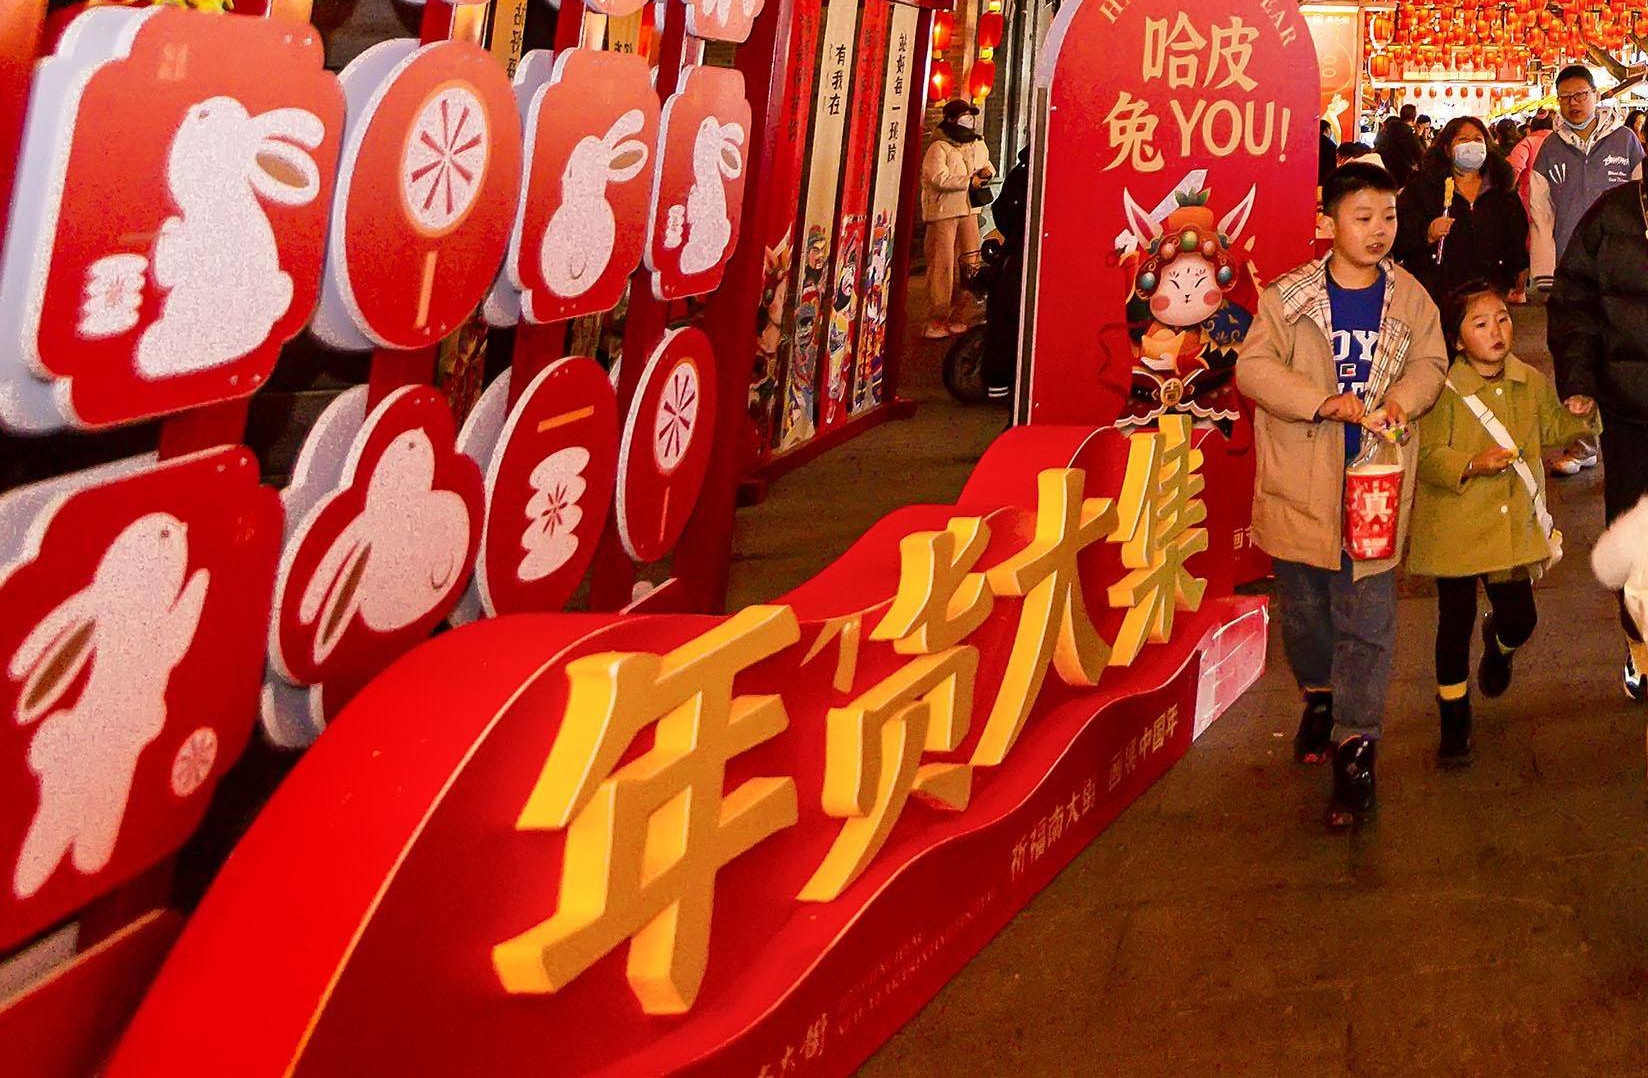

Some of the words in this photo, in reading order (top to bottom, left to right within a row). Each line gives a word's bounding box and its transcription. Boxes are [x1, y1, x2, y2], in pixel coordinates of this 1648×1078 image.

[827, 43, 847, 116] 有我在
[1142, 10, 1260, 92] 哈皮
[1100, 90, 1165, 173] 兔
[1168, 98, 1291, 163] YOU!
[491, 414, 1208, 1015] 年货大集
